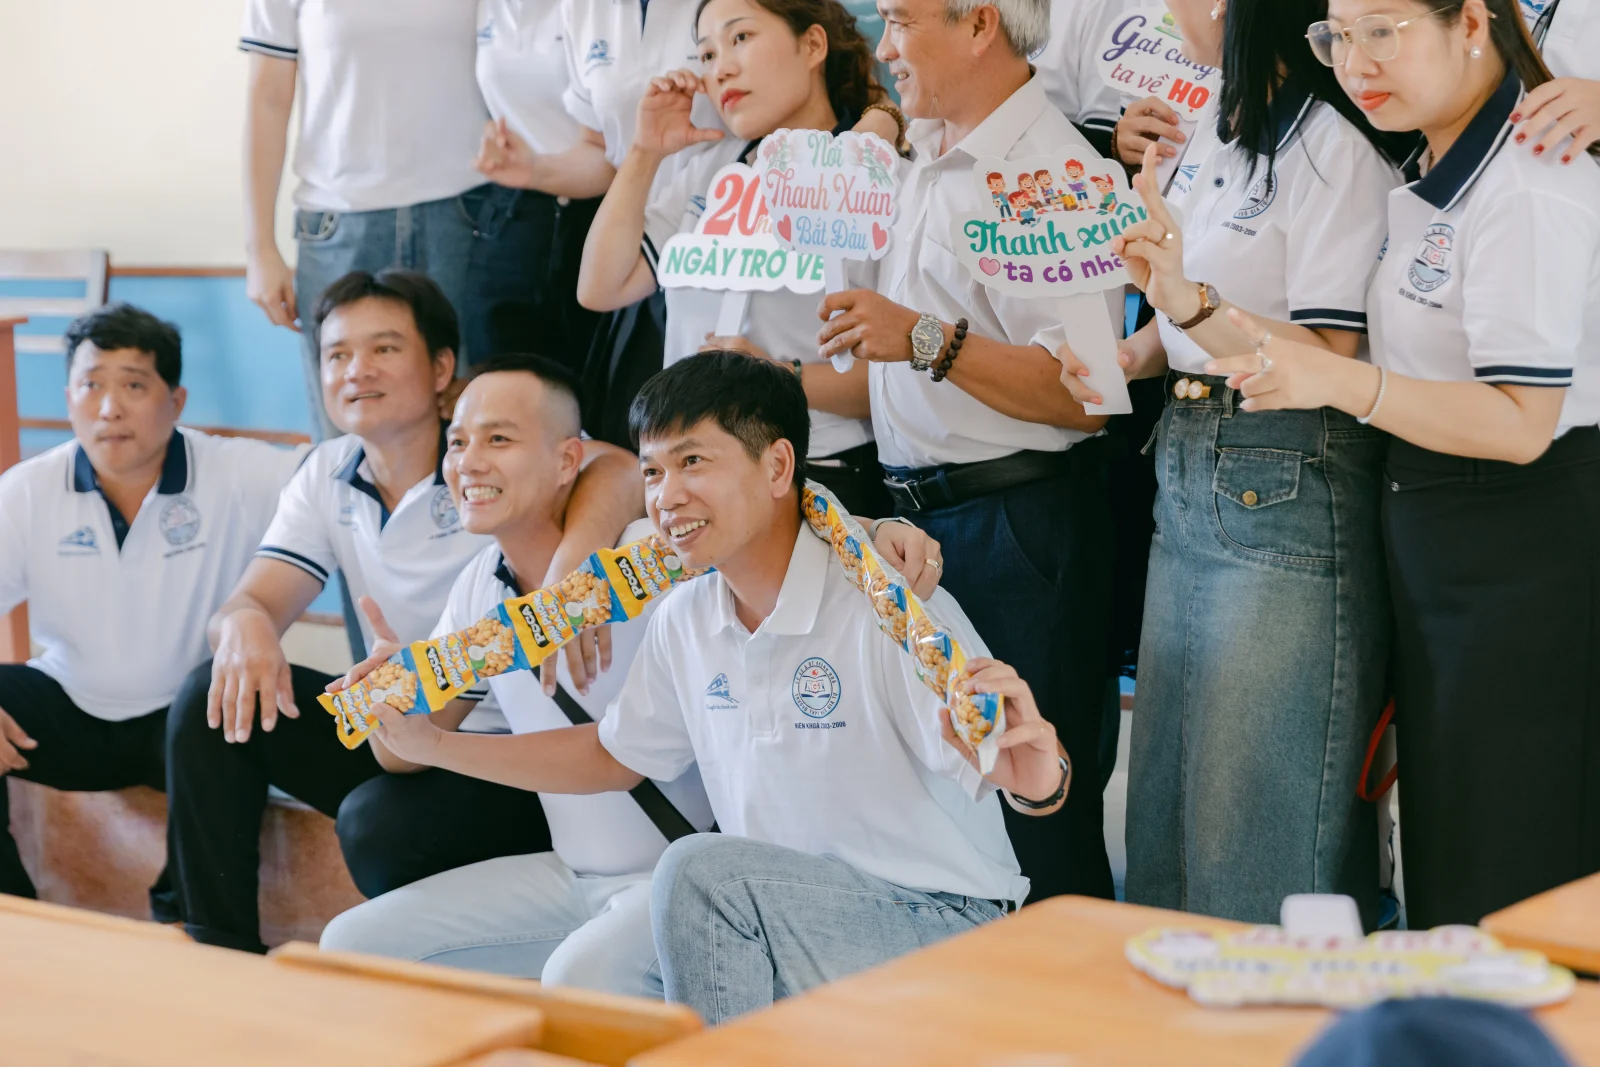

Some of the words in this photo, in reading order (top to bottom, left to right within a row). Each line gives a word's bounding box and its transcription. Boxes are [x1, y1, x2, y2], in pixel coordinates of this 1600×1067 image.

[1103, 15, 1163, 61] Gạt
[1111, 63, 1135, 84] ta
[1137, 73, 1170, 94] về
[1167, 77, 1214, 113] HỌ
[808, 133, 844, 168] Nơi
[702, 172, 769, 236] 20
[766, 168, 830, 211] Thanh
[833, 173, 895, 217] Xuân
[796, 215, 828, 246] Bắt
[830, 221, 868, 251] Đầu
[964, 219, 1075, 256] Thanh
[664, 238, 738, 276] NGÀY
[1003, 261, 1033, 283] ta
[1042, 260, 1073, 283] có
[618, 557, 645, 598] POCA
[521, 604, 546, 645] POCA
[427, 646, 447, 688] POCA
